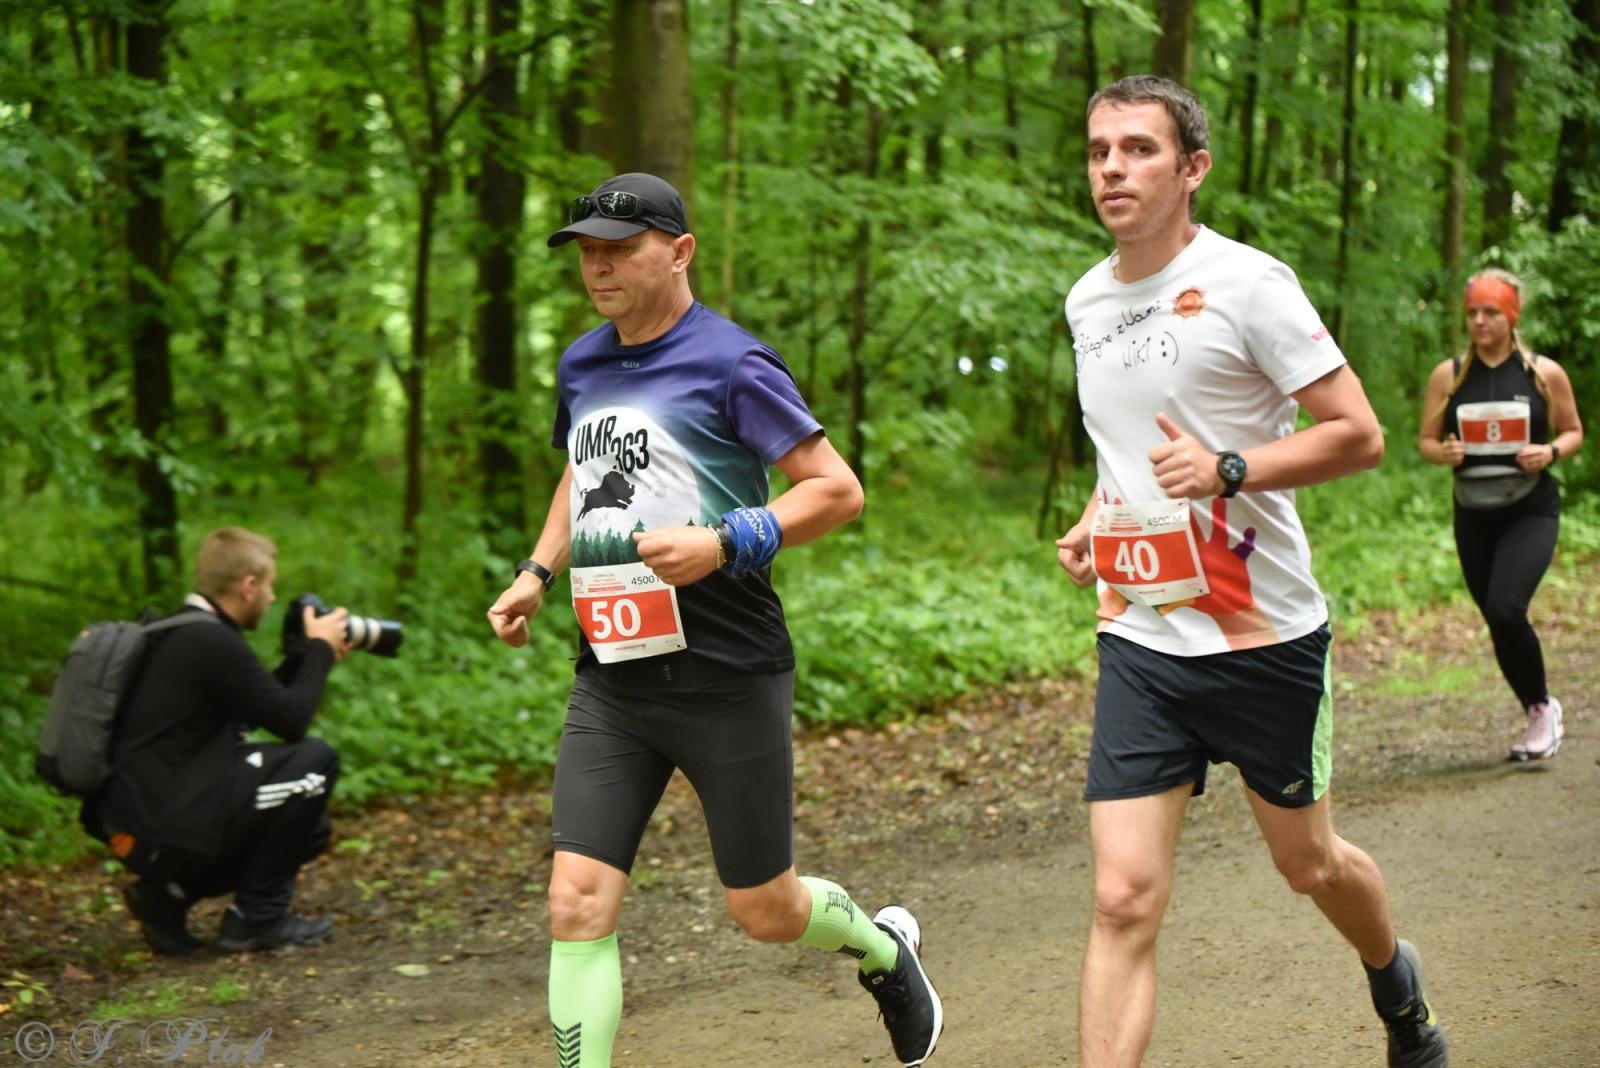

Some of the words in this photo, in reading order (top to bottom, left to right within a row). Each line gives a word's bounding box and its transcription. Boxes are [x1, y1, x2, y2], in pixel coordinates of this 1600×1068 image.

[575, 415, 617, 466] UMR
[610, 428, 650, 474] 363
[1487, 420, 1501, 442] 8
[631, 575, 655, 586] 4500
[1114, 540, 1160, 581] 40
[591, 598, 641, 640] 50
